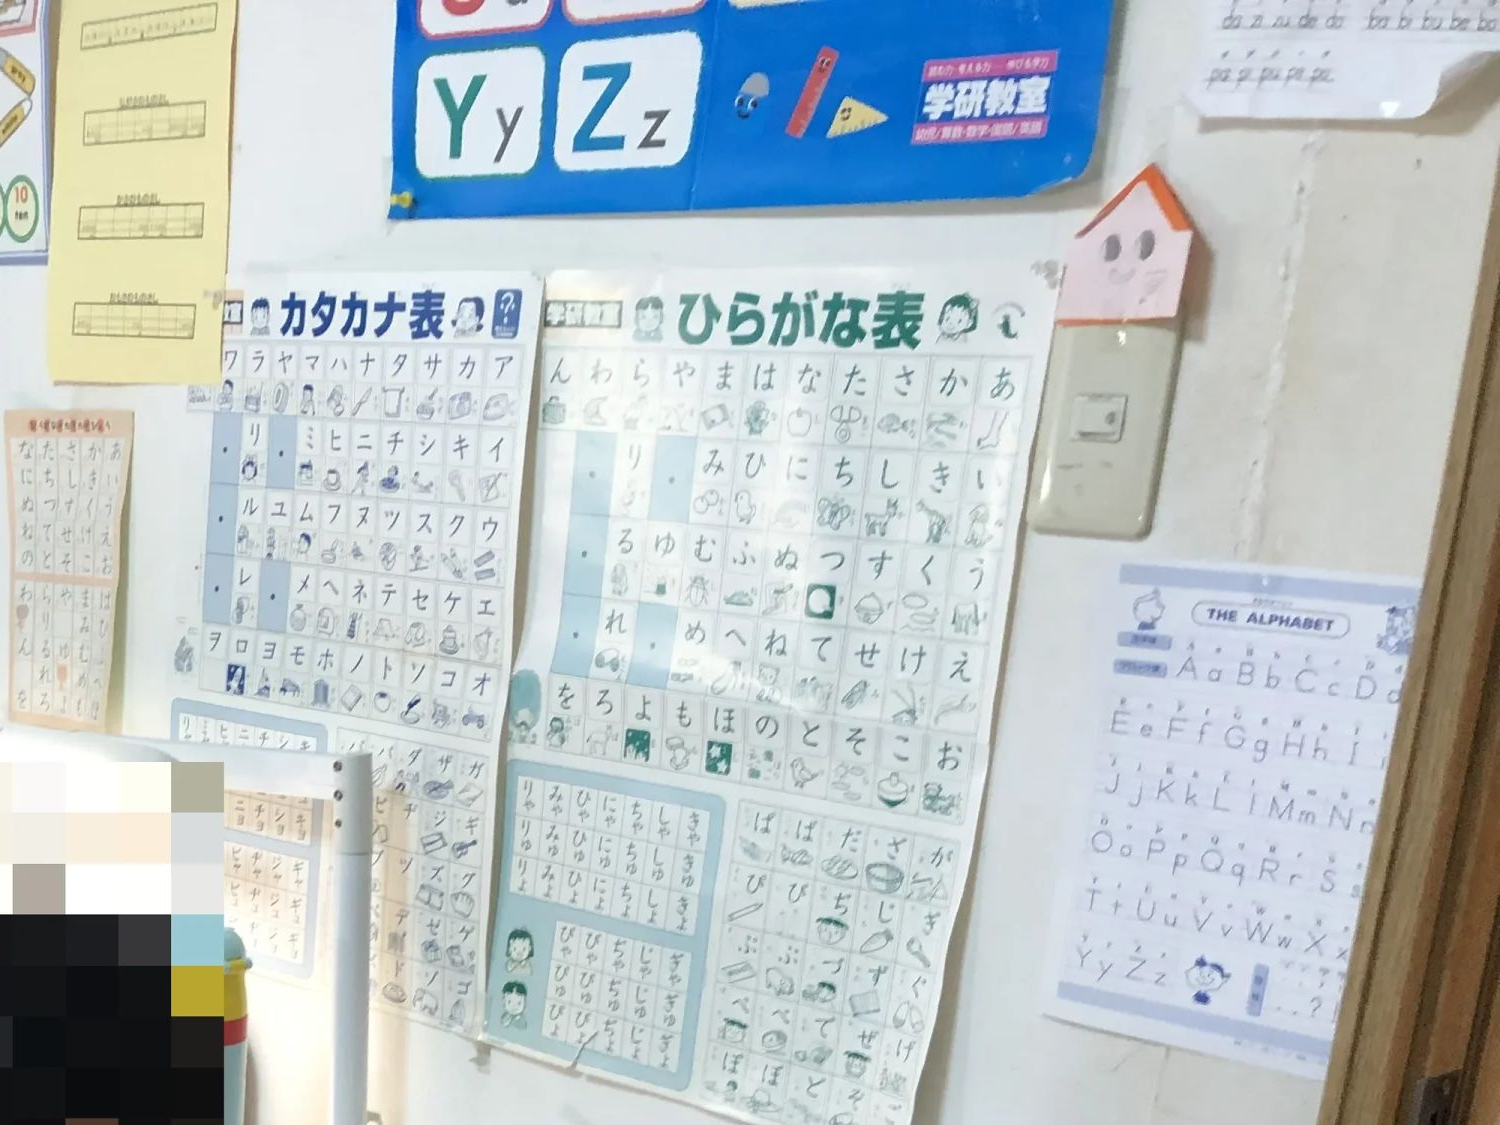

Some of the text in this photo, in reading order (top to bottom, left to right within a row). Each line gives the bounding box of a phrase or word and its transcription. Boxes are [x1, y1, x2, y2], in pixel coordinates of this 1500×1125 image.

[433, 74, 524, 164] Y y
[572, 61, 671, 153] Z z
[922, 75, 1051, 120] 学研教室
[14, 210, 28, 221] ten
[15, 187, 28, 203] 10
[280, 290, 446, 340] カタカナ表
[678, 290, 925, 350] ひらがな表
[549, 358, 1015, 400] ん わ ら や ま は な た さ か あ
[1206, 608, 1335, 632] THE ALPHABET
